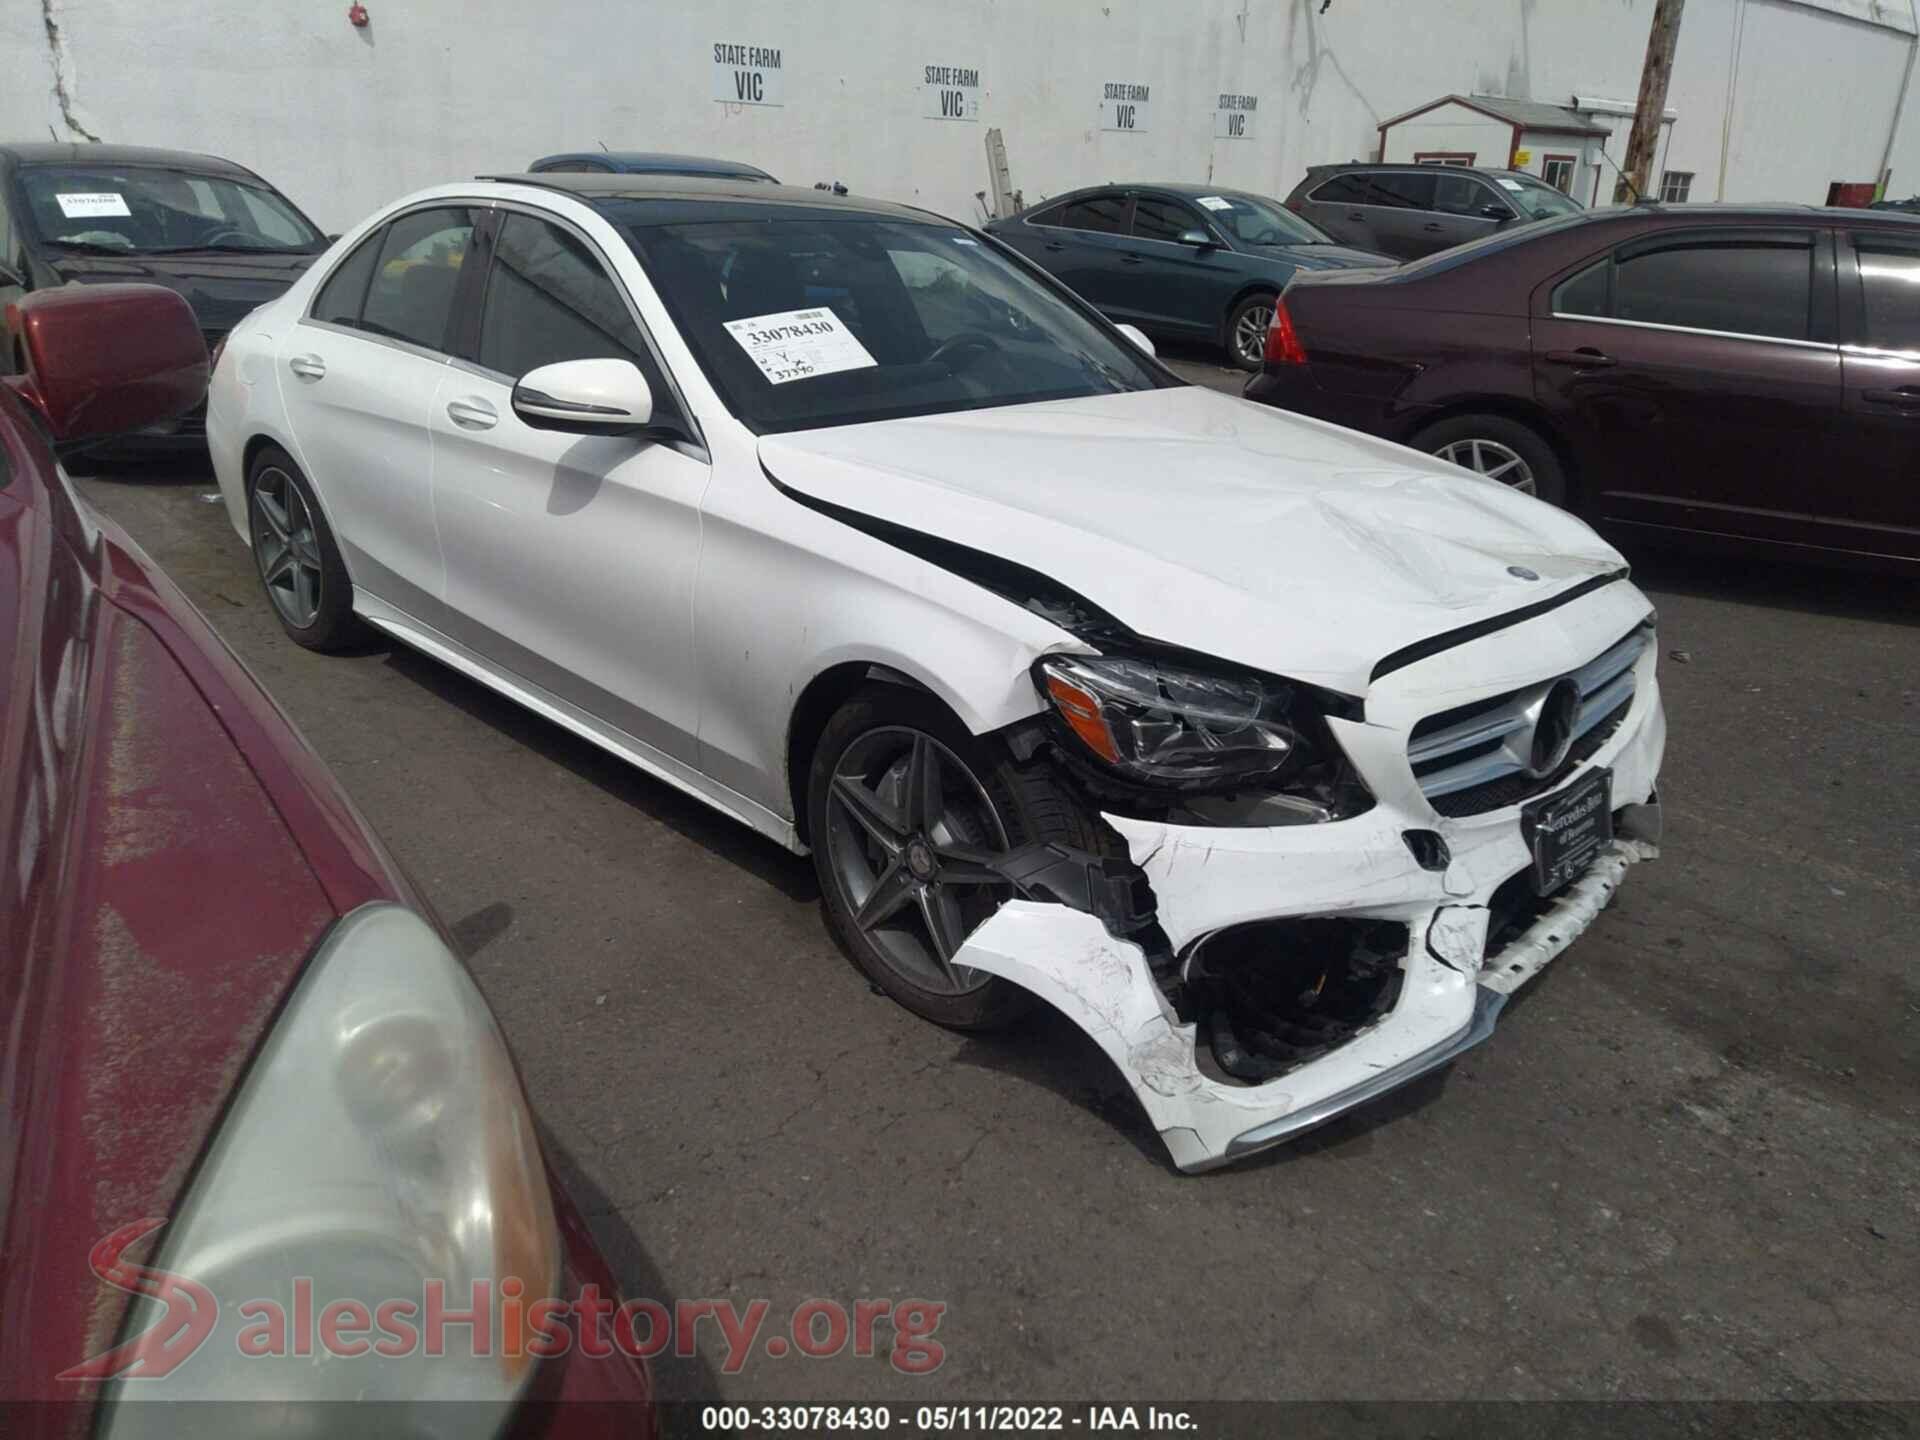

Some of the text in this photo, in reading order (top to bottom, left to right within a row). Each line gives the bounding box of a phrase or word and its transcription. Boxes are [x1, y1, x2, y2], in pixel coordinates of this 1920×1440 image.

[713, 43, 782, 69] STATE FARM
[734, 70, 763, 101] VIC
[924, 65, 979, 88] STATE FARM
[940, 90, 964, 117] VIC
[1103, 82, 1150, 101] STATE FARM
[1116, 104, 1136, 128] VIC
[1228, 114, 1246, 136] VIC
[747, 321, 834, 345] 33078430
